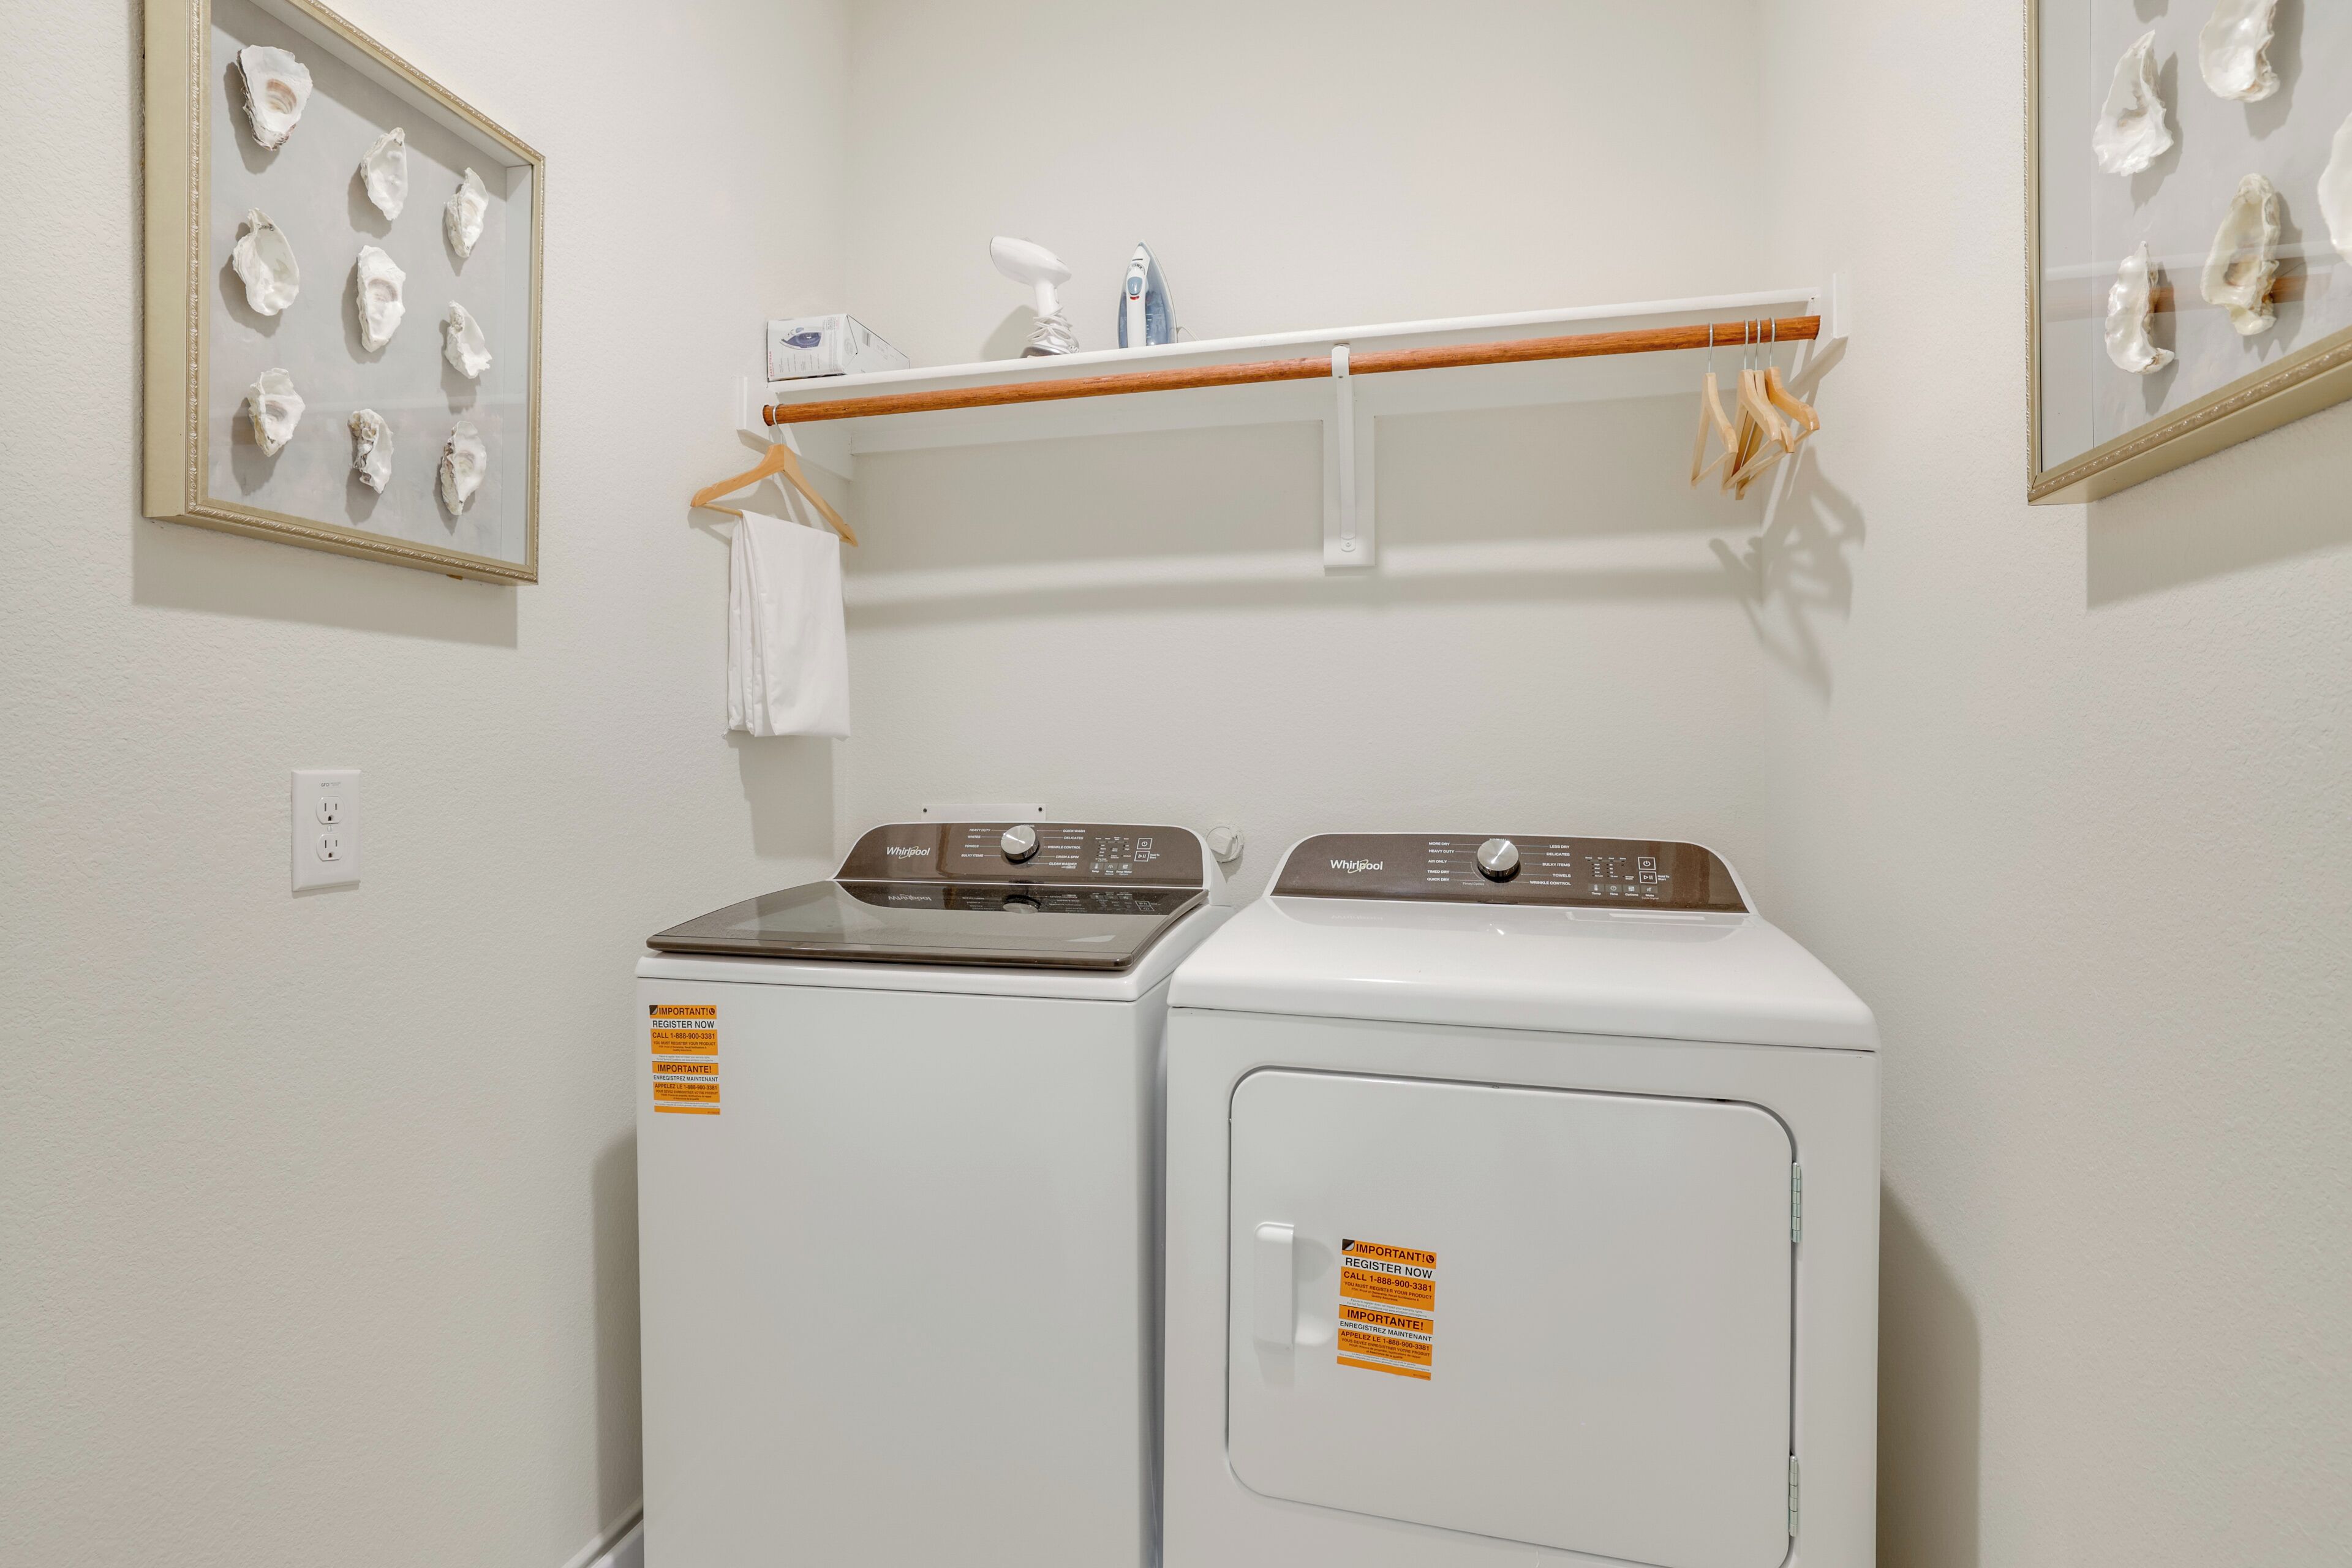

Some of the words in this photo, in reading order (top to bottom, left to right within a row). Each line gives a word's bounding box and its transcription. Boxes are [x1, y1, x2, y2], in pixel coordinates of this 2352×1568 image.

[887, 846, 931, 858] Whirlpool
[1330, 859, 1383, 873] Whirlpool
[658, 1064, 711, 1073] IMPORTANTE!
[1356, 1244, 1425, 1262] IMPORTANT!
[1345, 1257, 1401, 1274] REGISTER
[1405, 1267, 1432, 1279] NOW
[1344, 1271, 1367, 1281] CALL
[1370, 1275, 1432, 1292] 1-888-900-3381
[1348, 1309, 1423, 1330] IMPORTANTE!
[1340, 1321, 1386, 1334] ENREGISTREZ
[1388, 1329, 1432, 1341] MAINTENANT
[1341, 1331, 1371, 1340] APPELEZ
[1383, 1338, 1429, 1351] 1-888-900-3381
